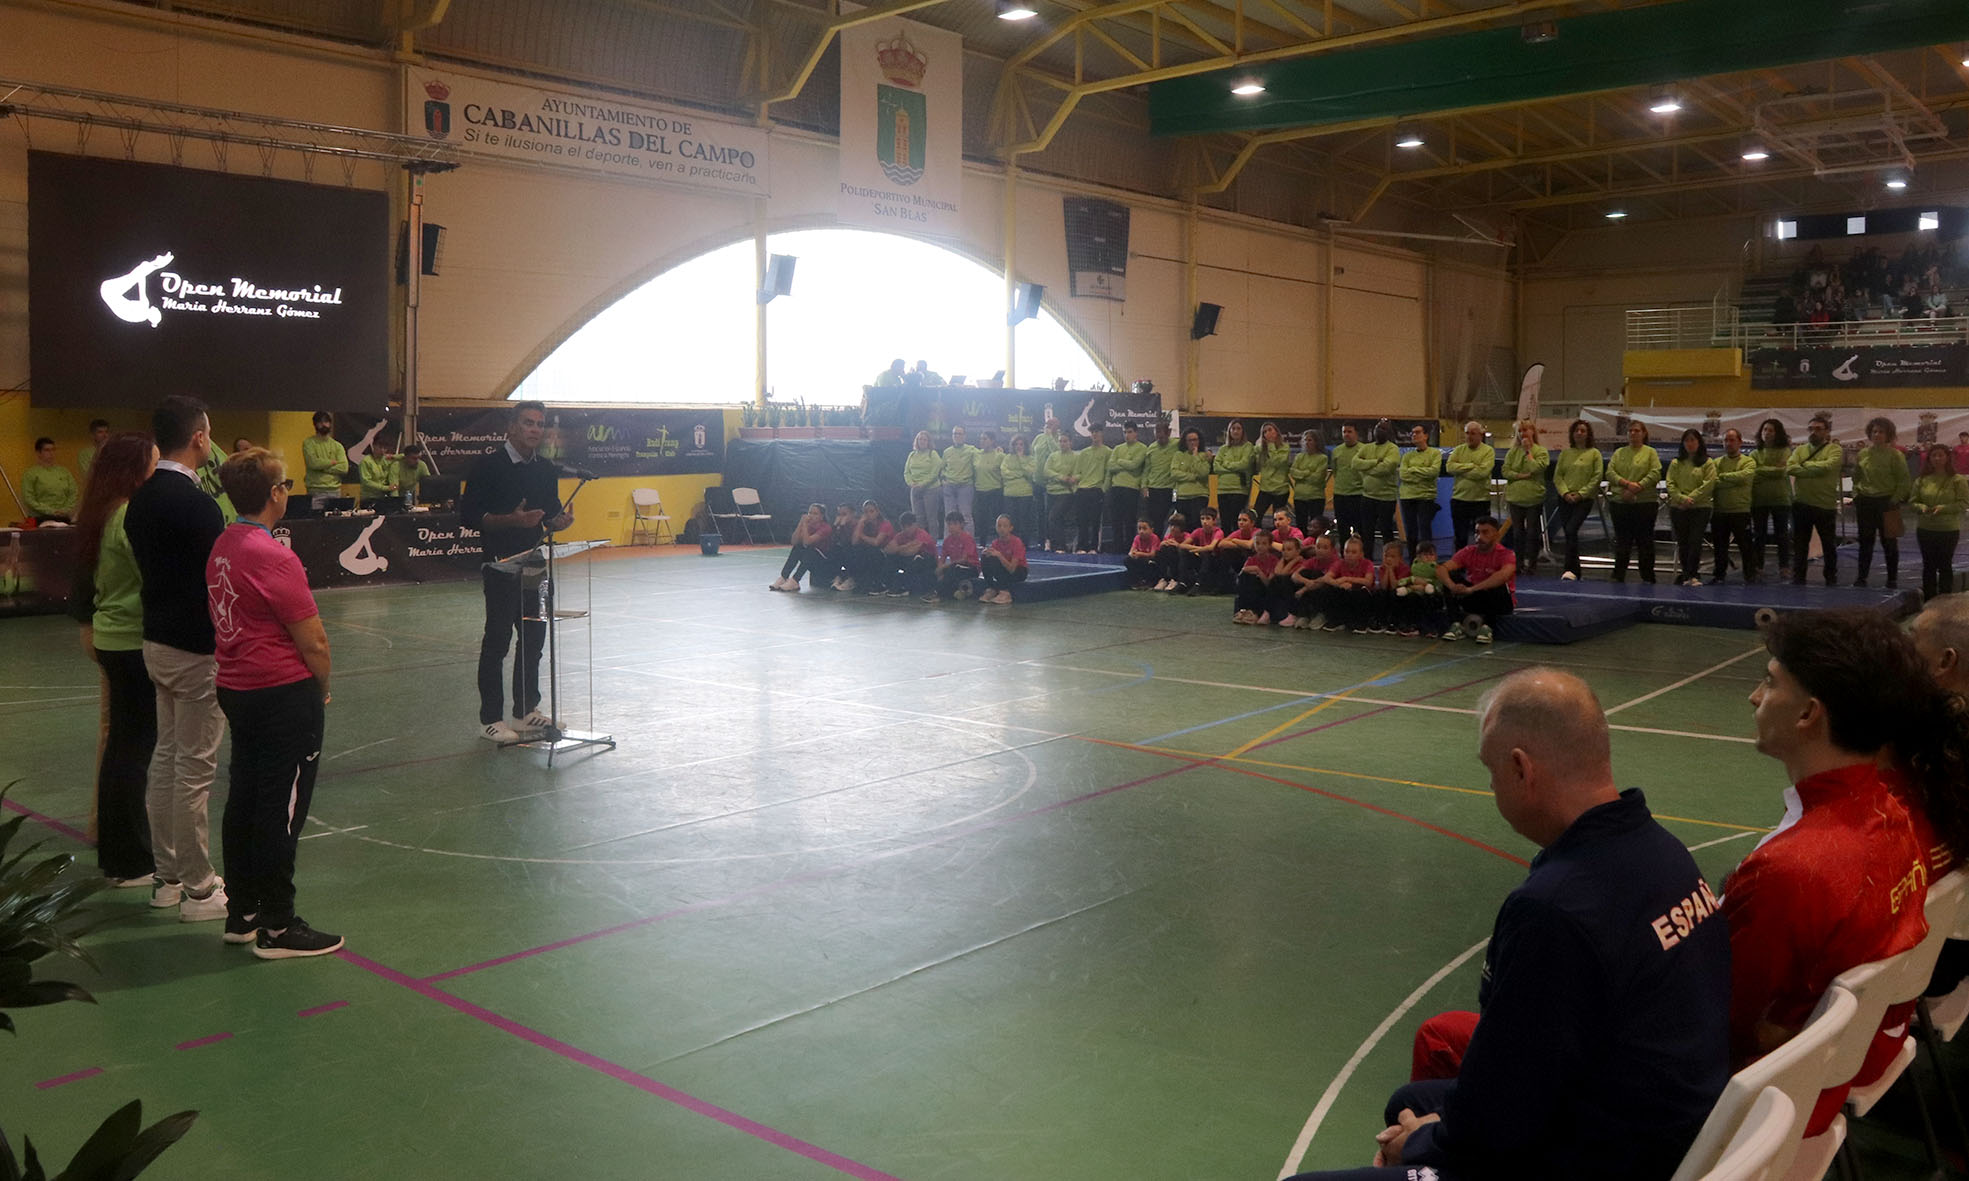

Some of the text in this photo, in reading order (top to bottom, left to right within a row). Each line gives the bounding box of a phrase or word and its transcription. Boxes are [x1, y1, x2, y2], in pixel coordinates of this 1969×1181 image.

[541, 98, 692, 136] AYUNTAMIENTO DE
[463, 104, 755, 169] CABANILLAS DEL CAMPO
[463, 128, 756, 185] Si te ilusiona el deporte, ven a practicarlo
[840, 182, 958, 212] POLIDEPORTIVO MUNICIPAL
[160, 272, 342, 304] Open Memorial
[211, 299, 272, 316] Herranz
[1874, 359, 1943, 368] Open Memorial
[1108, 408, 1157, 419] Open Memorial
[450, 432, 509, 442] Memorial
[440, 446, 482, 456] Herranz
[417, 528, 455, 542] Open
[447, 543, 483, 556] Herra
[1651, 877, 1720, 951] ESPAÑ
